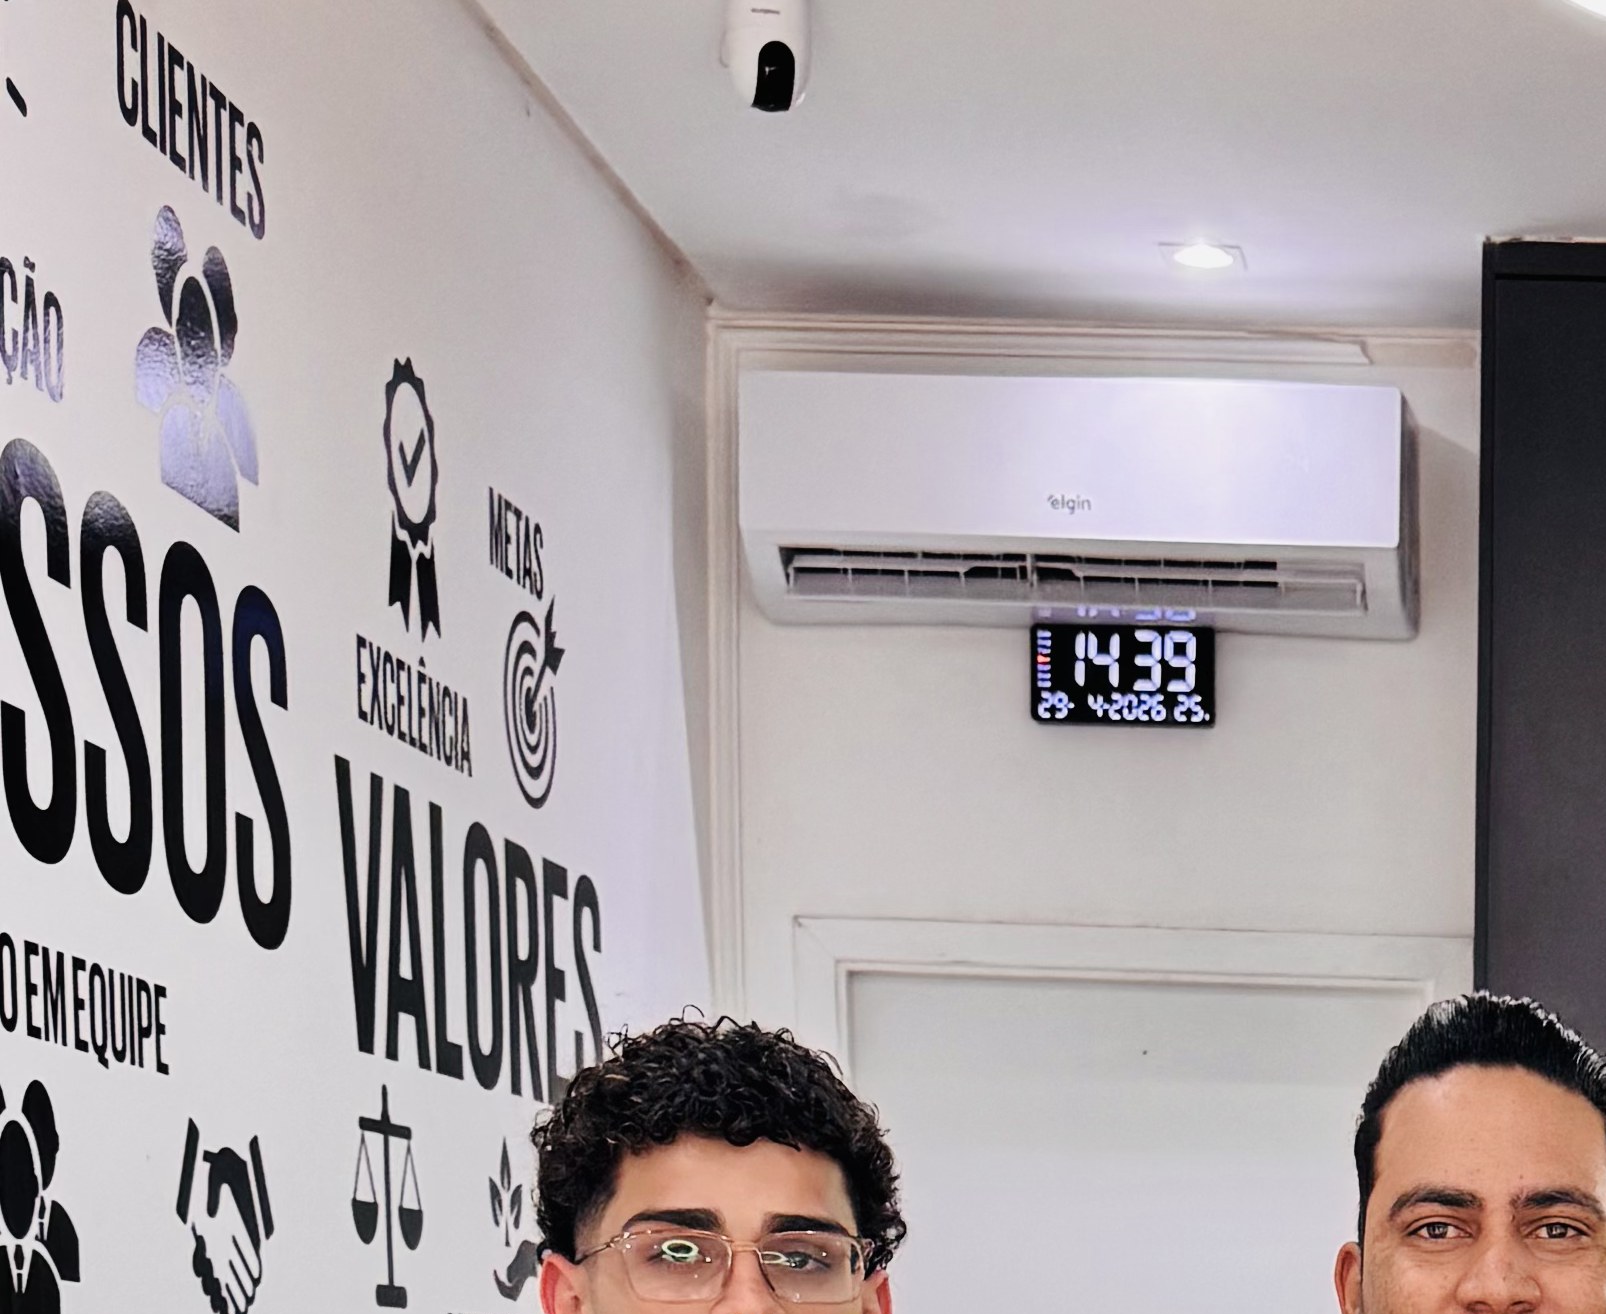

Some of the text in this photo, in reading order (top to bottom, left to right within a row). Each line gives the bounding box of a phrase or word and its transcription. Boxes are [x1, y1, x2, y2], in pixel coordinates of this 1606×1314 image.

[116, 0, 266, 240] CLIENTES
[488, 487, 544, 600] METAS
[1048, 494, 1092, 514] elgin
[356, 633, 472, 778] EXCELÊNCIA
[334, 753, 603, 1104] VALORES
[24, 940, 67, 1047] EM
[72, 955, 169, 1076] EQUIPE
